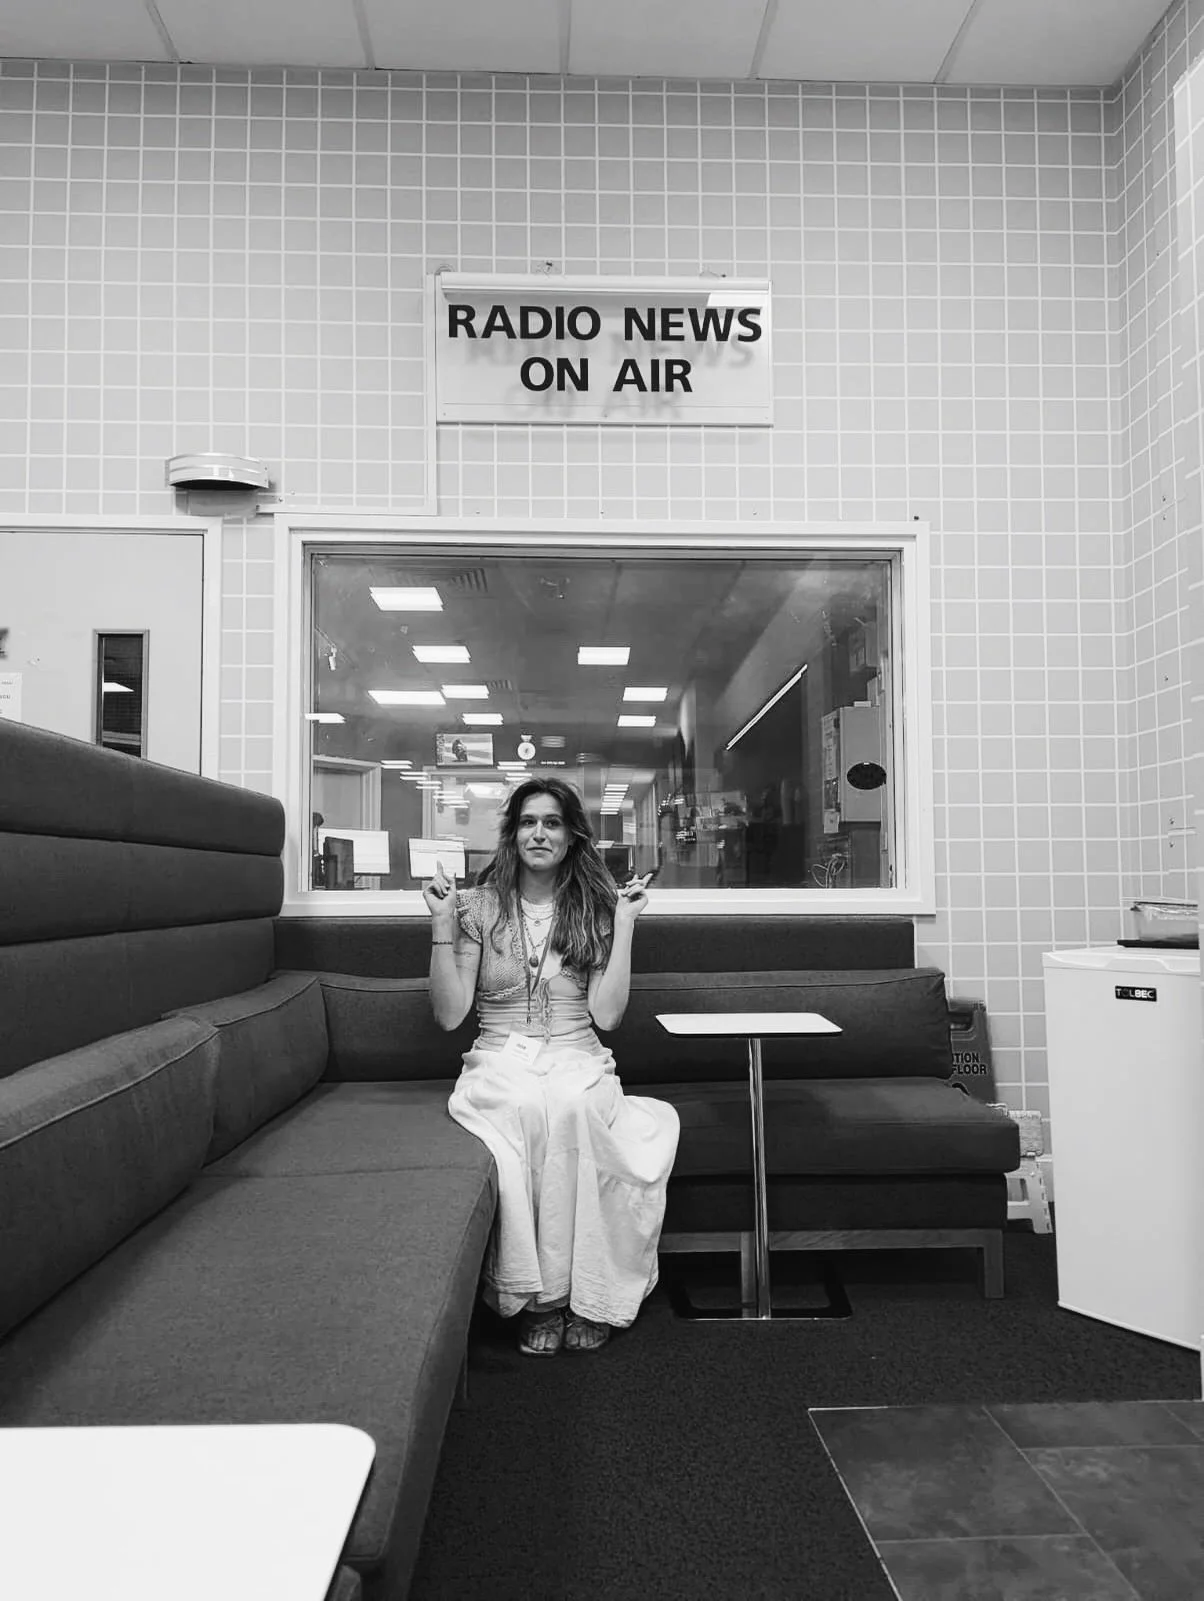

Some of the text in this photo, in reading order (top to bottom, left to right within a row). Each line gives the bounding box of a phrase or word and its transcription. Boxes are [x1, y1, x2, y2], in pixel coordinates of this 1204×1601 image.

[448, 304, 763, 343] RADIO NEWS
[520, 356, 693, 393] ON AIR
[952, 1064, 987, 1075] FLOOR
